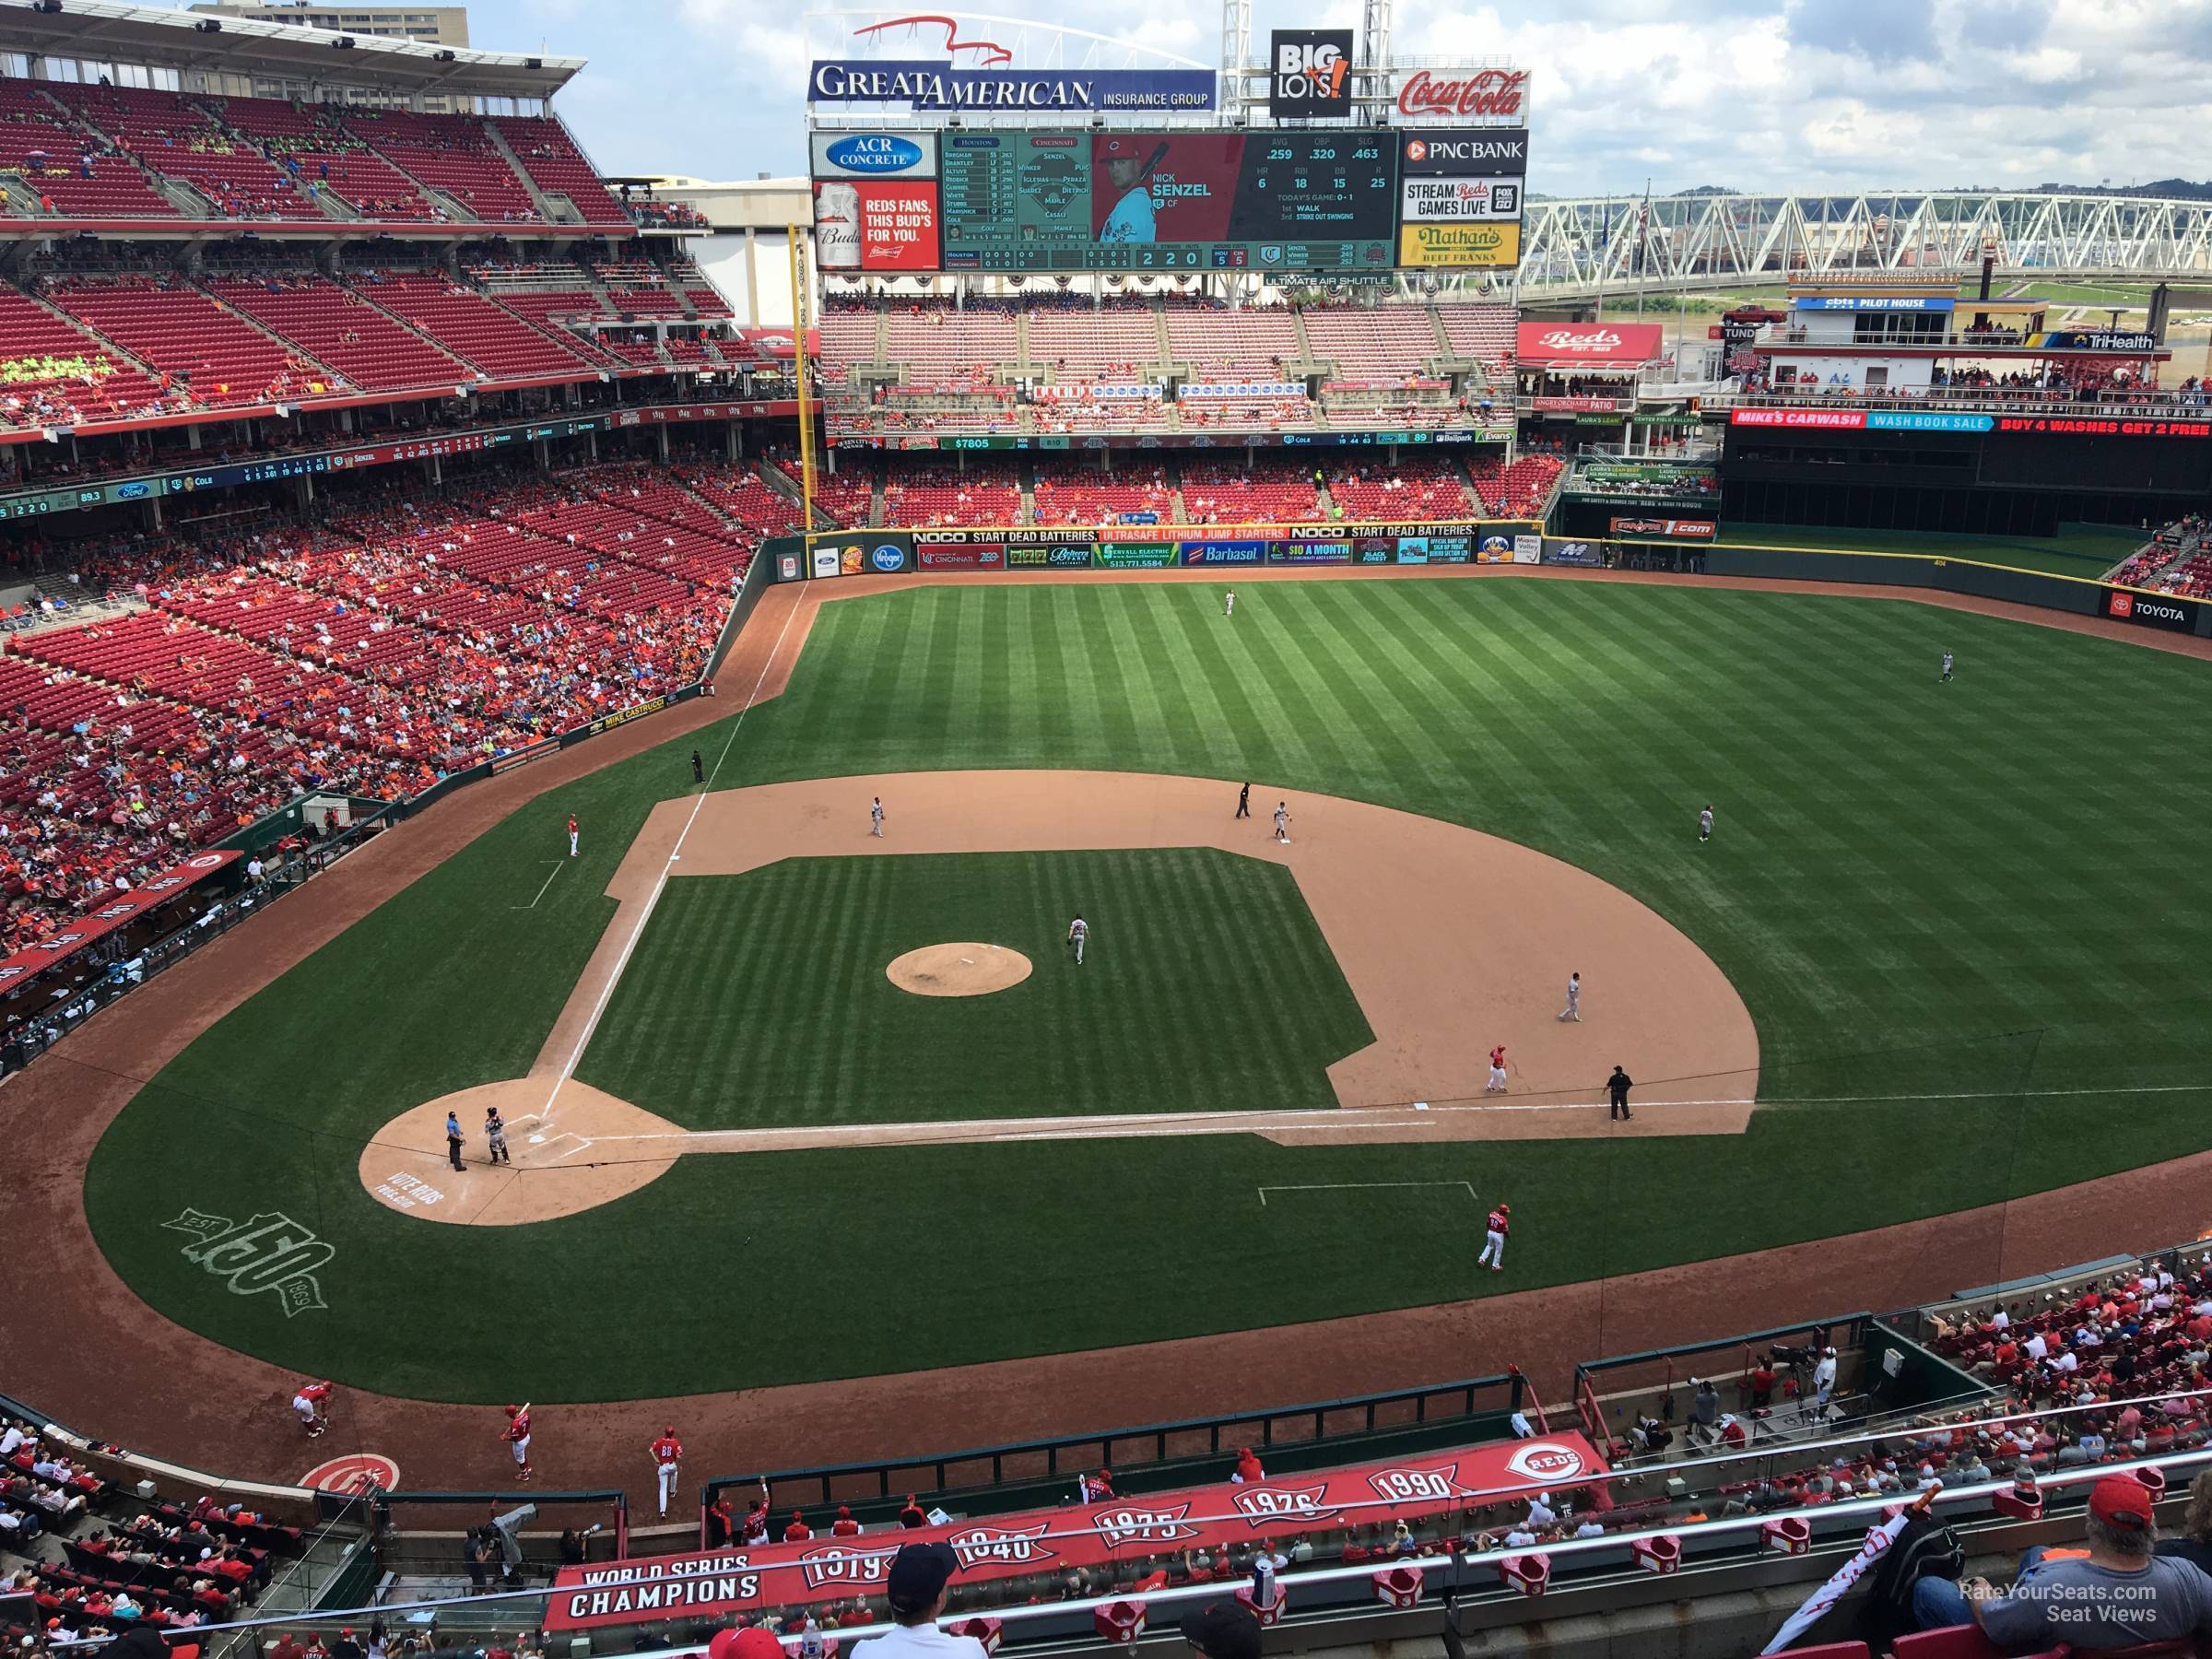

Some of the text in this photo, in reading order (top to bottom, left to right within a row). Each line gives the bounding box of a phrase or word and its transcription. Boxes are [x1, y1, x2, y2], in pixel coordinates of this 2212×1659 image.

[1279, 44, 1342, 74] BIG
[816, 65, 1208, 106] GREAT AMERICAN INSURANCE GROUP
[1397, 69, 1532, 115] Coca-Cola
[855, 138, 893, 152] ACR
[840, 154, 907, 165] CONCRETE
[1266, 148, 1378, 159] .259 .320 .463
[1153, 173, 1175, 182] NICK
[1258, 178, 1385, 189] 6 18 15 25
[1152, 184, 1211, 196] SENZEL
[1407, 181, 1489, 200] STREAM Reds
[1495, 188, 1513, 197] FOX
[866, 199, 932, 214] REDS FANS,
[1418, 200, 1486, 215] GAMES LIVE
[1495, 201, 1512, 209] GO
[866, 215, 932, 227] THIS BUD'S
[867, 229, 920, 242] FOR YOU.
[1418, 227, 1501, 246] Nathan's
[1143, 253, 1196, 265] 2 2 0
[1218, 256, 1242, 265] 5 5
[1453, 253, 1496, 262] FRANKS
[1266, 276, 1387, 286] ULTIMATE AIR SHUTTLE
[1859, 299, 1889, 308] PILOT
[1890, 298, 1925, 308] HOUSE
[1538, 329, 1622, 349] Reds
[2089, 335, 2153, 349] TriHealth
[1590, 401, 1612, 410] PATIO
[1736, 410, 2210, 436] MIKE'S CARWASH WASH BOOK SALE BUY 4 WASHES GET 2 FREE
[1444, 434, 1473, 443] Ballpark
[1485, 431, 1511, 441] Evans
[955, 439, 989, 449] $7805
[194, 477, 213, 486] COLE
[80, 491, 100, 502] 89.3
[123, 484, 145, 498] Ford
[18, 502, 47, 515] 2 2 0
[912, 524, 1476, 544] NOCO START DEAD BATTERIES. ULTRASAFE LITHIUM JUMP STARTERS. NOCO START DEAD BATTERIES.
[1206, 547, 1257, 561] Barbasol
[1288, 544, 1349, 555] $10 A MONTH
[877, 549, 900, 568] Kroger
[2135, 602, 2185, 622] TOYOTA
[605, 713, 625, 727] MIKE
[625, 699, 665, 718] CASTRUCCI
[386, 1171, 444, 1205] VOTE REDS
[374, 1182, 416, 1209] reds.com
[184, 1218, 217, 1231] EST.
[288, 1279, 311, 1307] 1869
[1528, 1452, 1579, 1470] REDS
[1377, 1473, 1452, 1500] 1990
[1242, 1492, 1316, 1517] 1976
[1564, 1508, 1572, 1518] 15
[1102, 1512, 1178, 1541] 1975
[958, 1531, 1030, 1563] 1940
[584, 1555, 748, 1585] WORLD SERIES
[810, 1550, 881, 1582] 1919
[570, 1575, 759, 1618] CHAMPIONS
